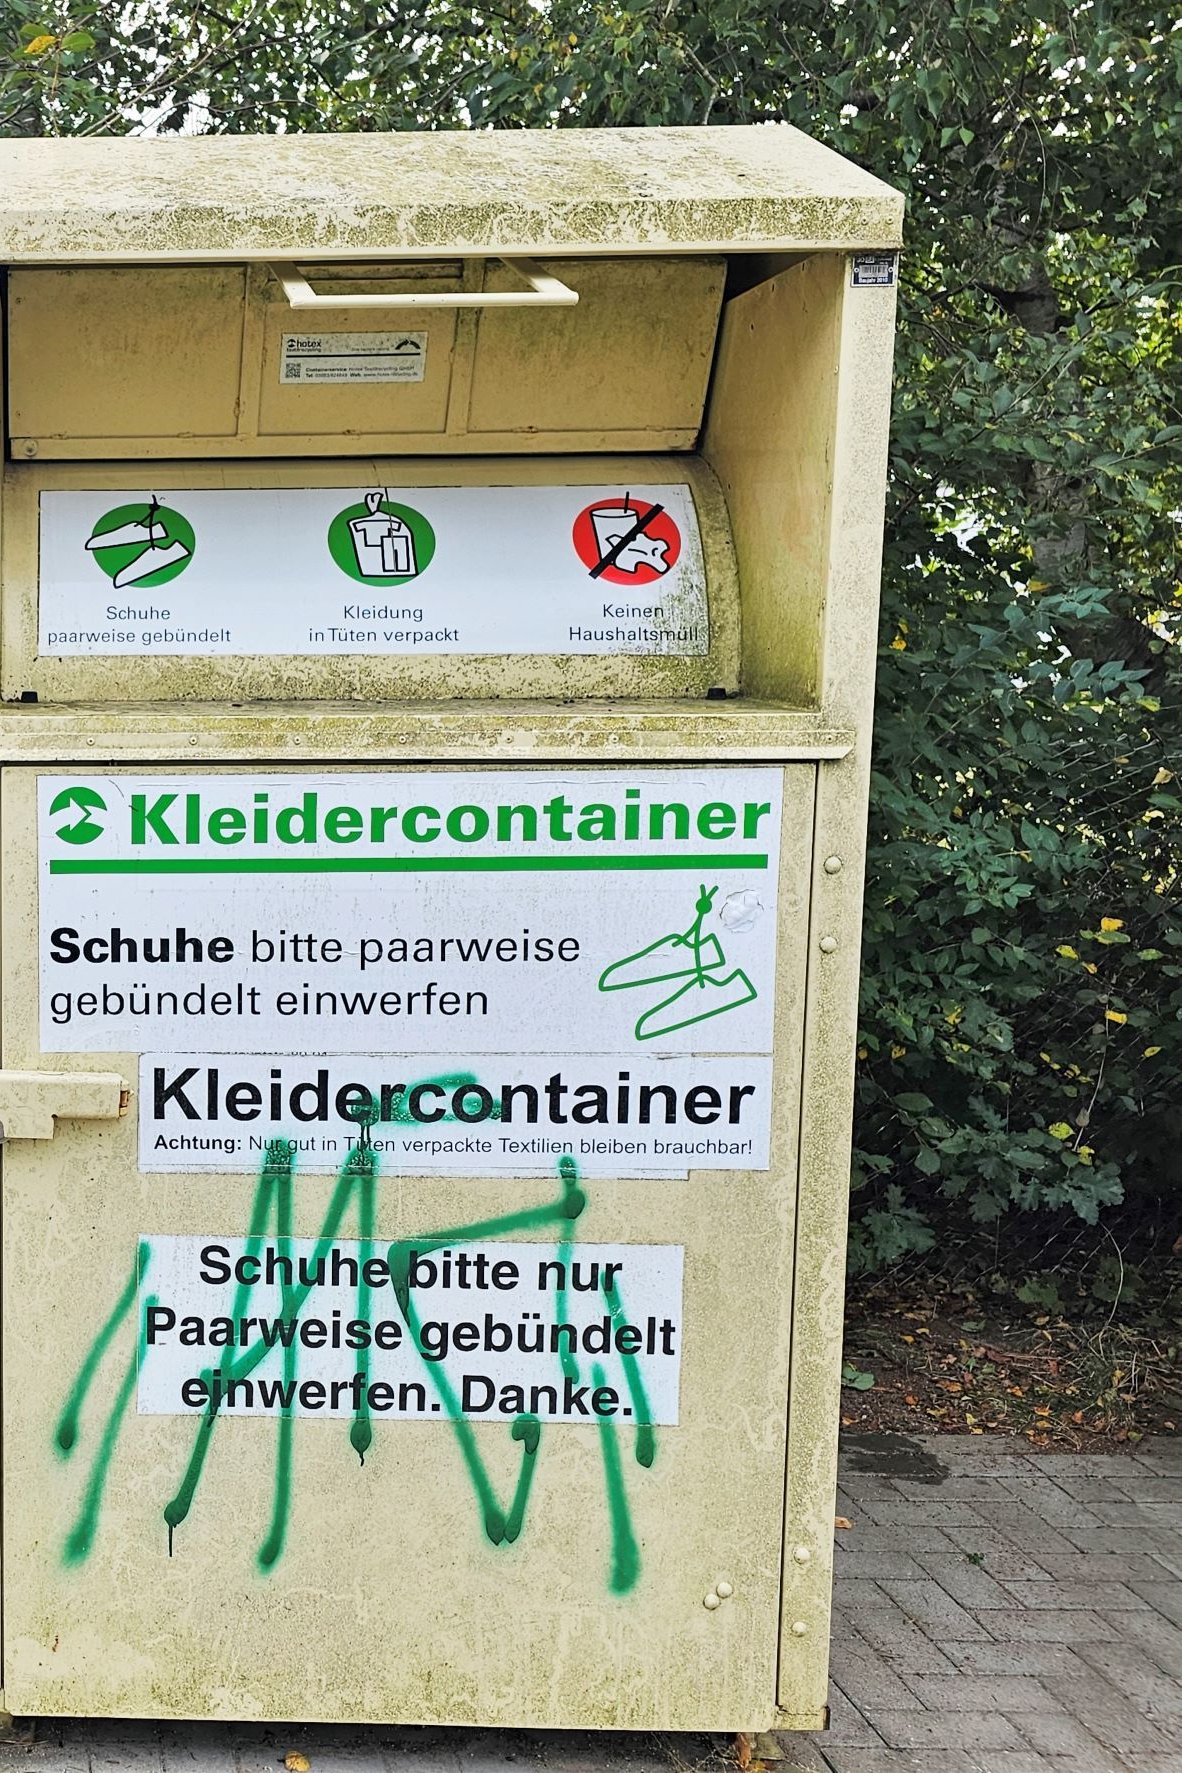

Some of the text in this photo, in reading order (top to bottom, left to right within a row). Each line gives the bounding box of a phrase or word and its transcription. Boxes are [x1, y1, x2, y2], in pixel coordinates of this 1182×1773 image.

[106, 606, 170, 620] Schuhe
[344, 605, 423, 622] Kleidung
[603, 604, 664, 618] Keinen
[48, 628, 230, 646] paarweise gebündelt
[309, 627, 459, 645] in Tüten verpackt
[569, 626, 698, 641] Haushaltsmüll
[131, 788, 771, 845] Kleidercontainer
[49, 927, 580, 971] Schuhe bitte paarweise
[50, 982, 488, 1025] gebündelt einwerfen
[153, 1067, 756, 1125] Kleidercontainer
[154, 1134, 241, 1154] Achtung:
[249, 1135, 282, 1151] Nur
[287, 1137, 316, 1154] gut
[322, 1136, 337, 1151] in
[402, 1137, 492, 1156] verpackte
[498, 1137, 573, 1153] Textilien
[580, 1138, 647, 1154] bleiben
[654, 1139, 752, 1155] brauchbar!
[199, 1244, 623, 1293] Schuhe bitte nur
[146, 1306, 676, 1362] Paarweise gebündelt
[181, 1368, 632, 1417] einwerfen. Danke.
